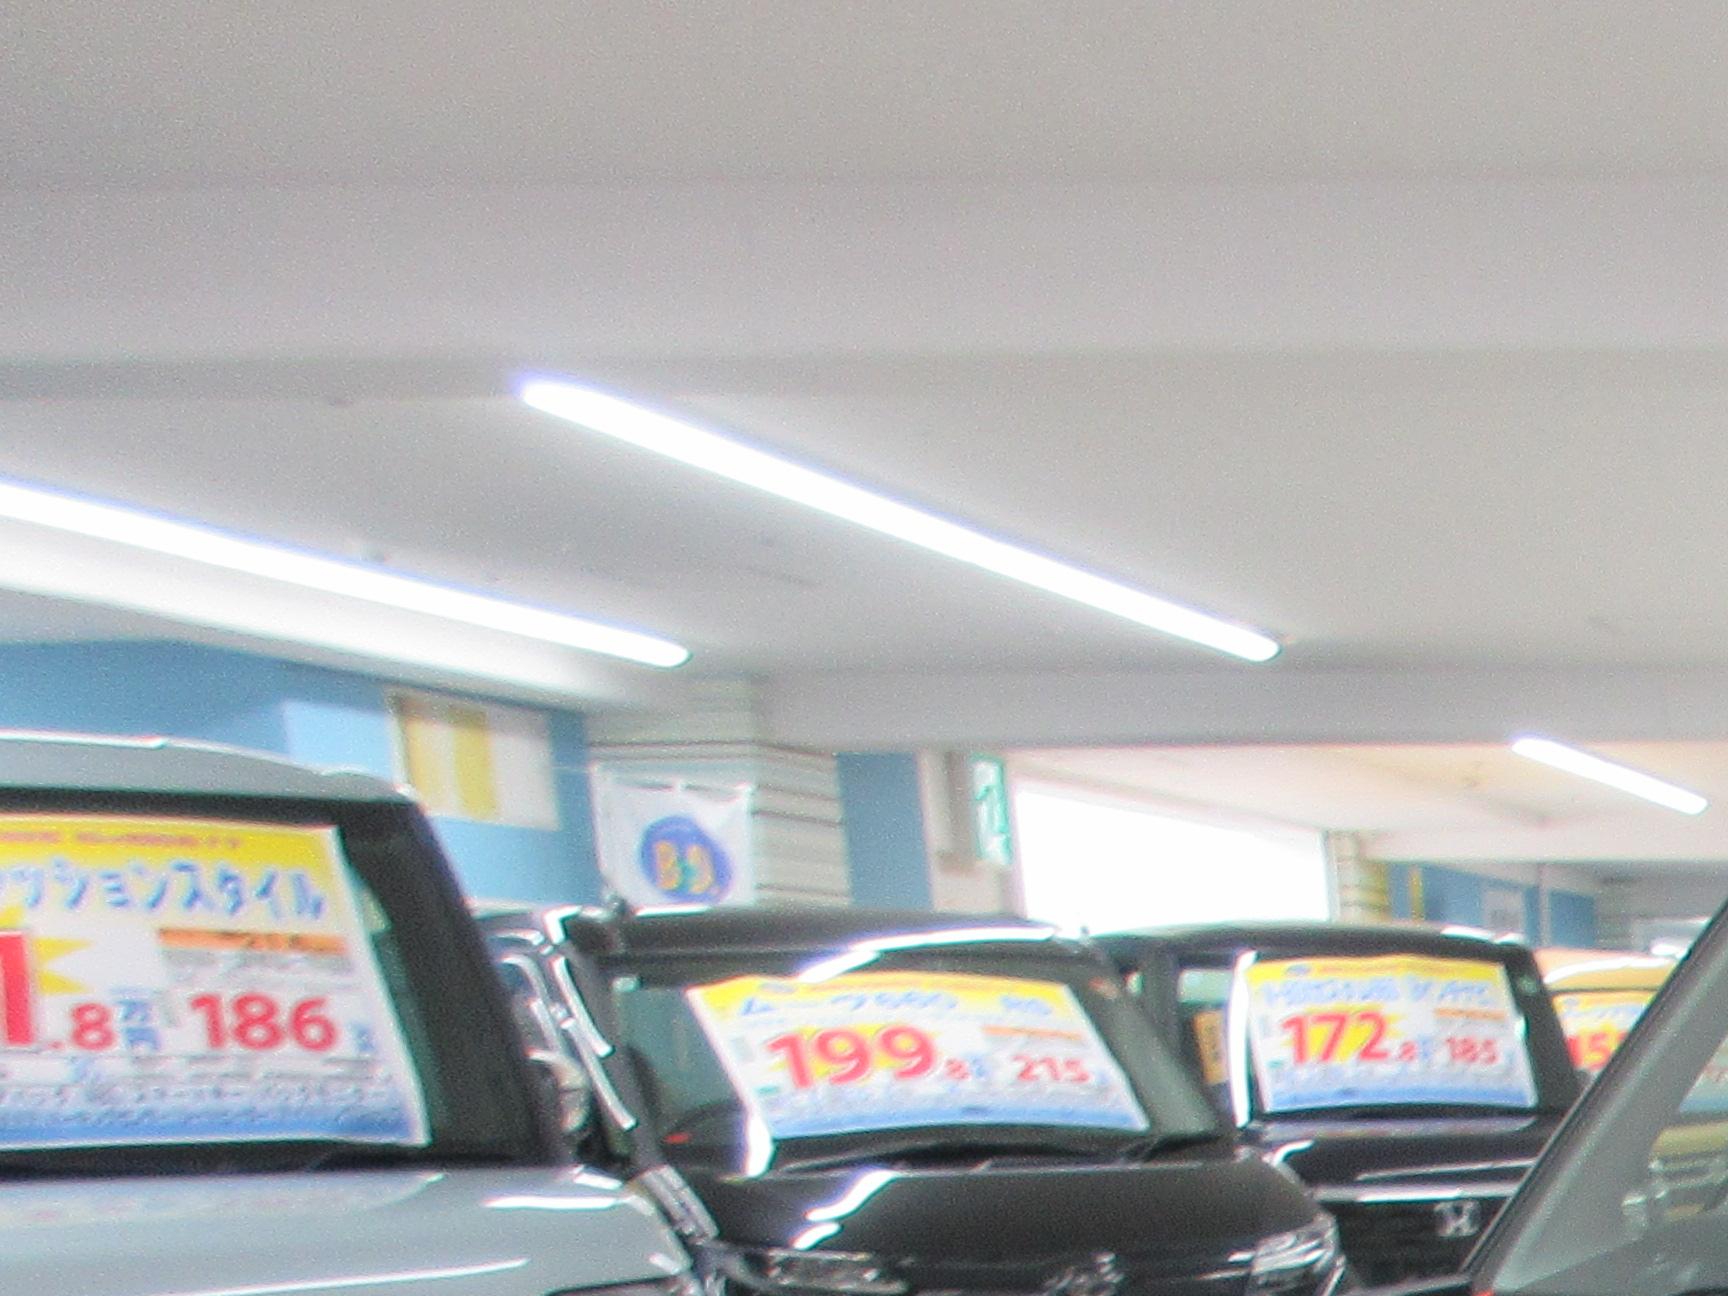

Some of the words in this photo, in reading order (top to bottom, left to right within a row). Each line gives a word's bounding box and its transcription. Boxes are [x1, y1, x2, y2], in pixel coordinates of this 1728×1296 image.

[0, 857, 327, 922] ッションスタイル
[191, 993, 337, 1052] 186
